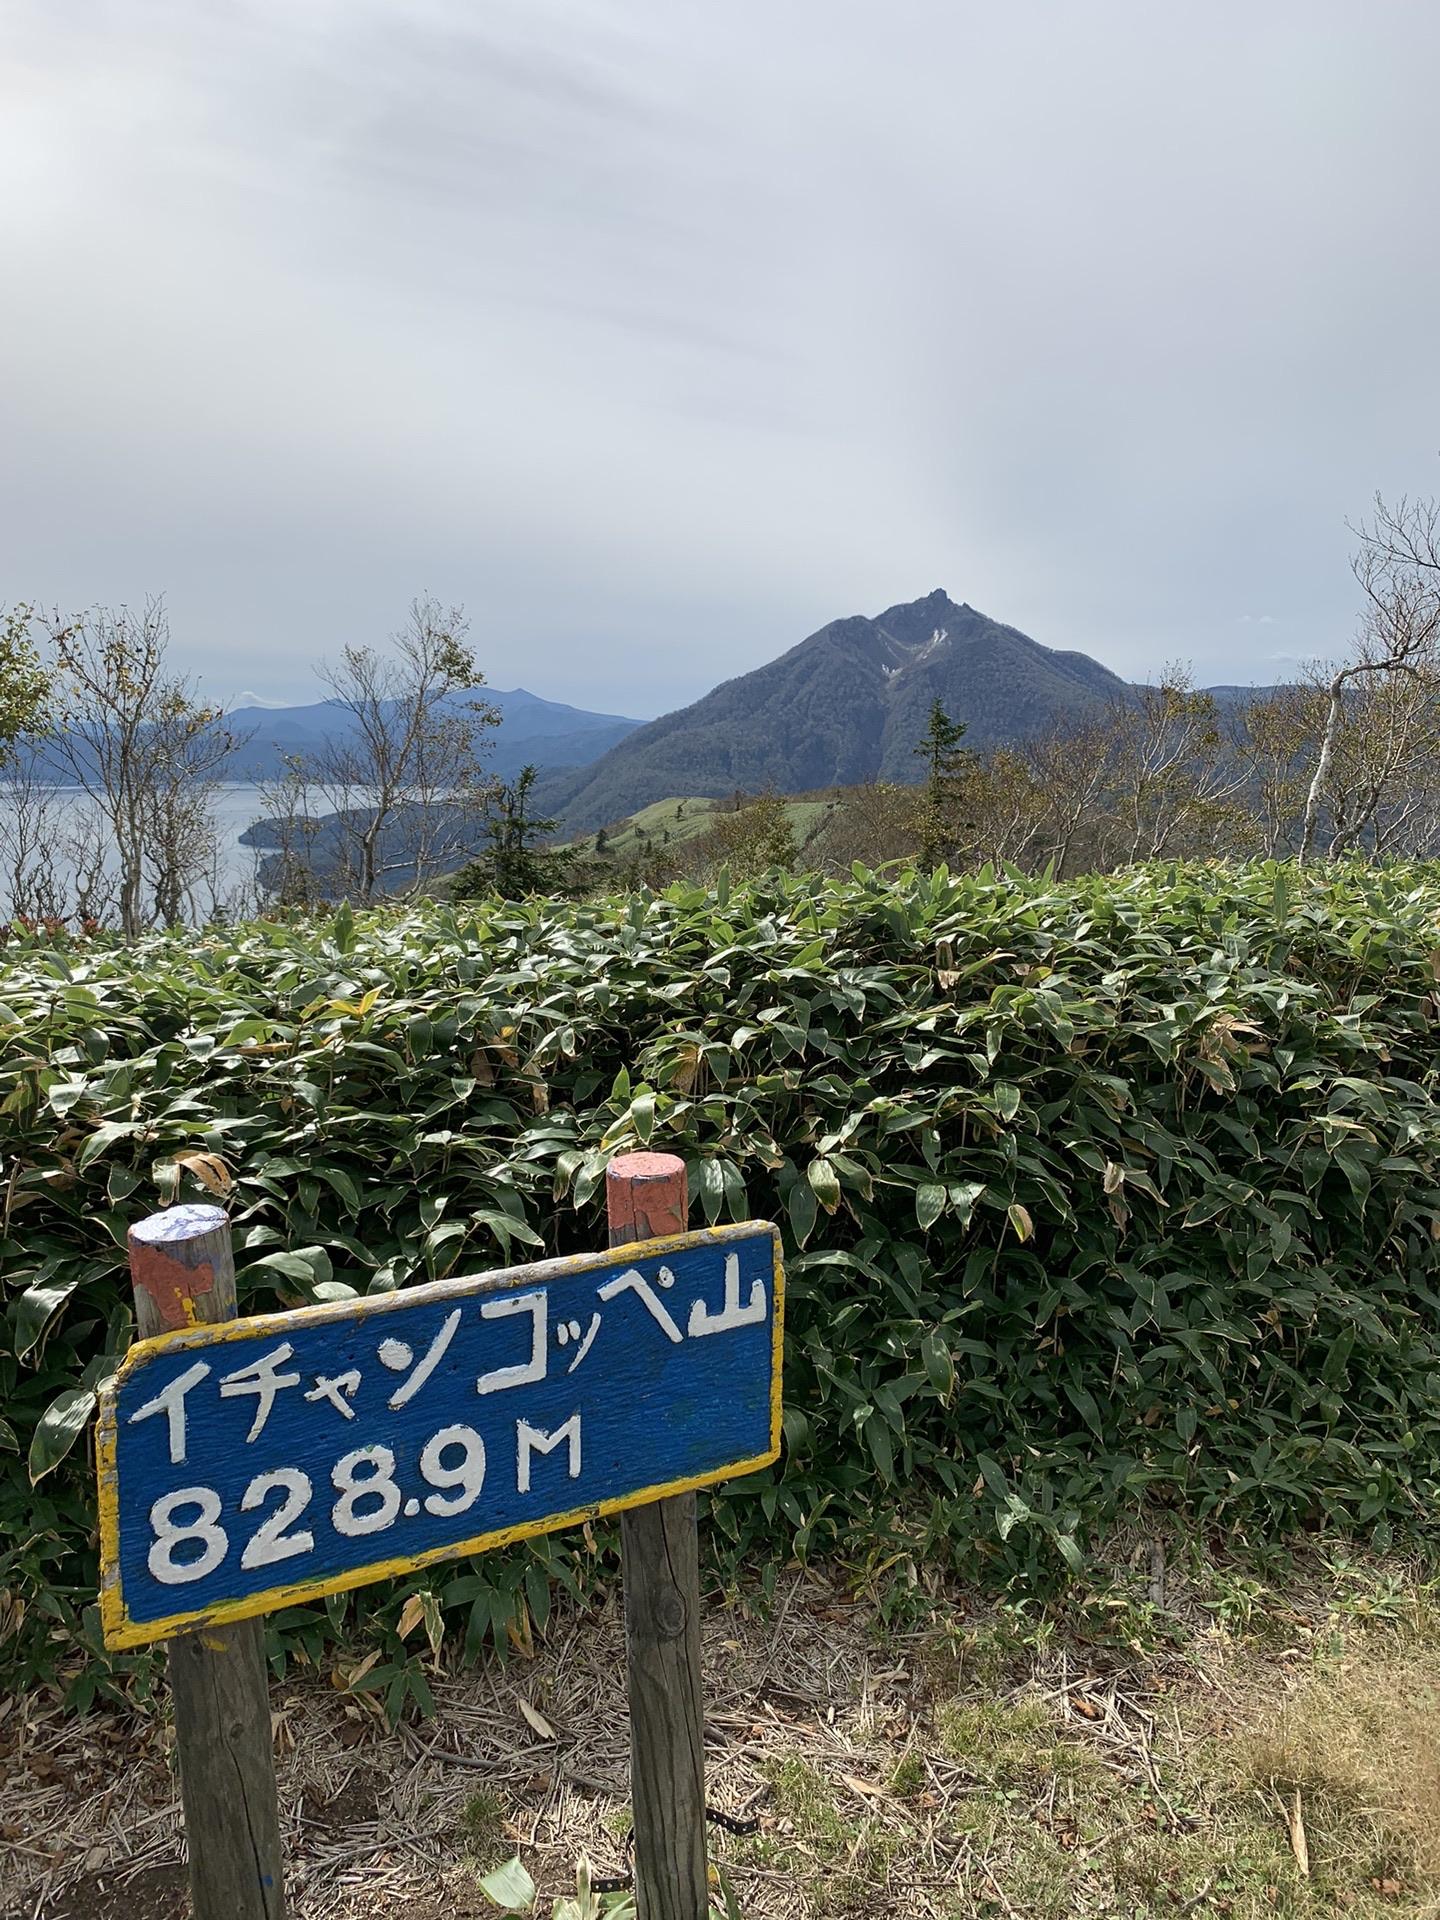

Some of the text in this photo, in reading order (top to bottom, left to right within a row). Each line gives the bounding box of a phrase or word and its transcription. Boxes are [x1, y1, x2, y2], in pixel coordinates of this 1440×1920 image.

[130, 1252, 768, 1463] イチャンコッペ山
[147, 1415, 581, 1584] 828.9 M
